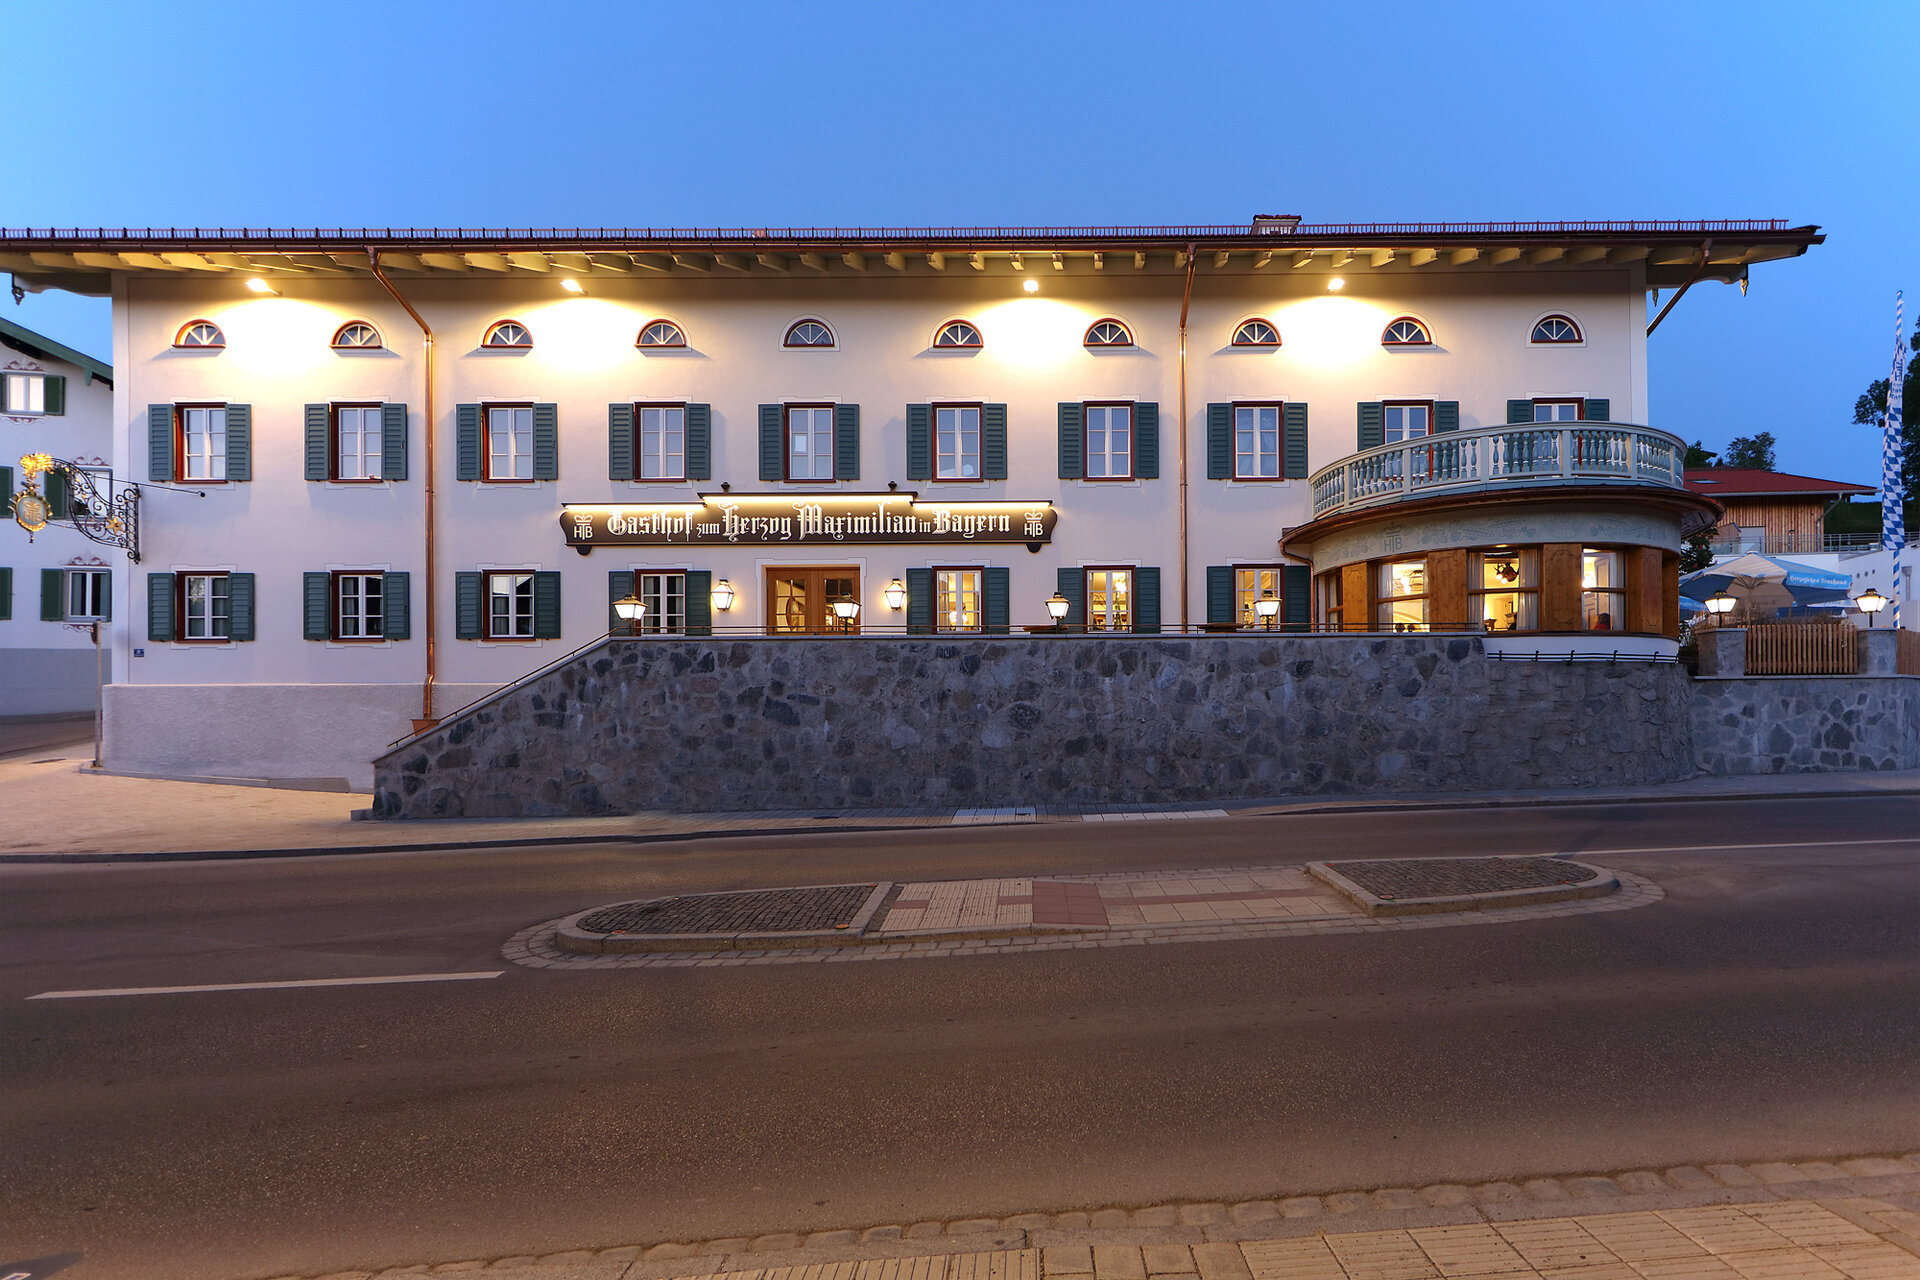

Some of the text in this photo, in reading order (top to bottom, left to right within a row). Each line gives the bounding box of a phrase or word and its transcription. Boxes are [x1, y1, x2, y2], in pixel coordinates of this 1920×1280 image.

[607, 501, 1010, 542] Gasthof zum Herzog Maximilian in Bayern
[1024, 521, 1044, 537] HTB
[573, 523, 593, 540] HTB
[1383, 535, 1403, 552] HTB
